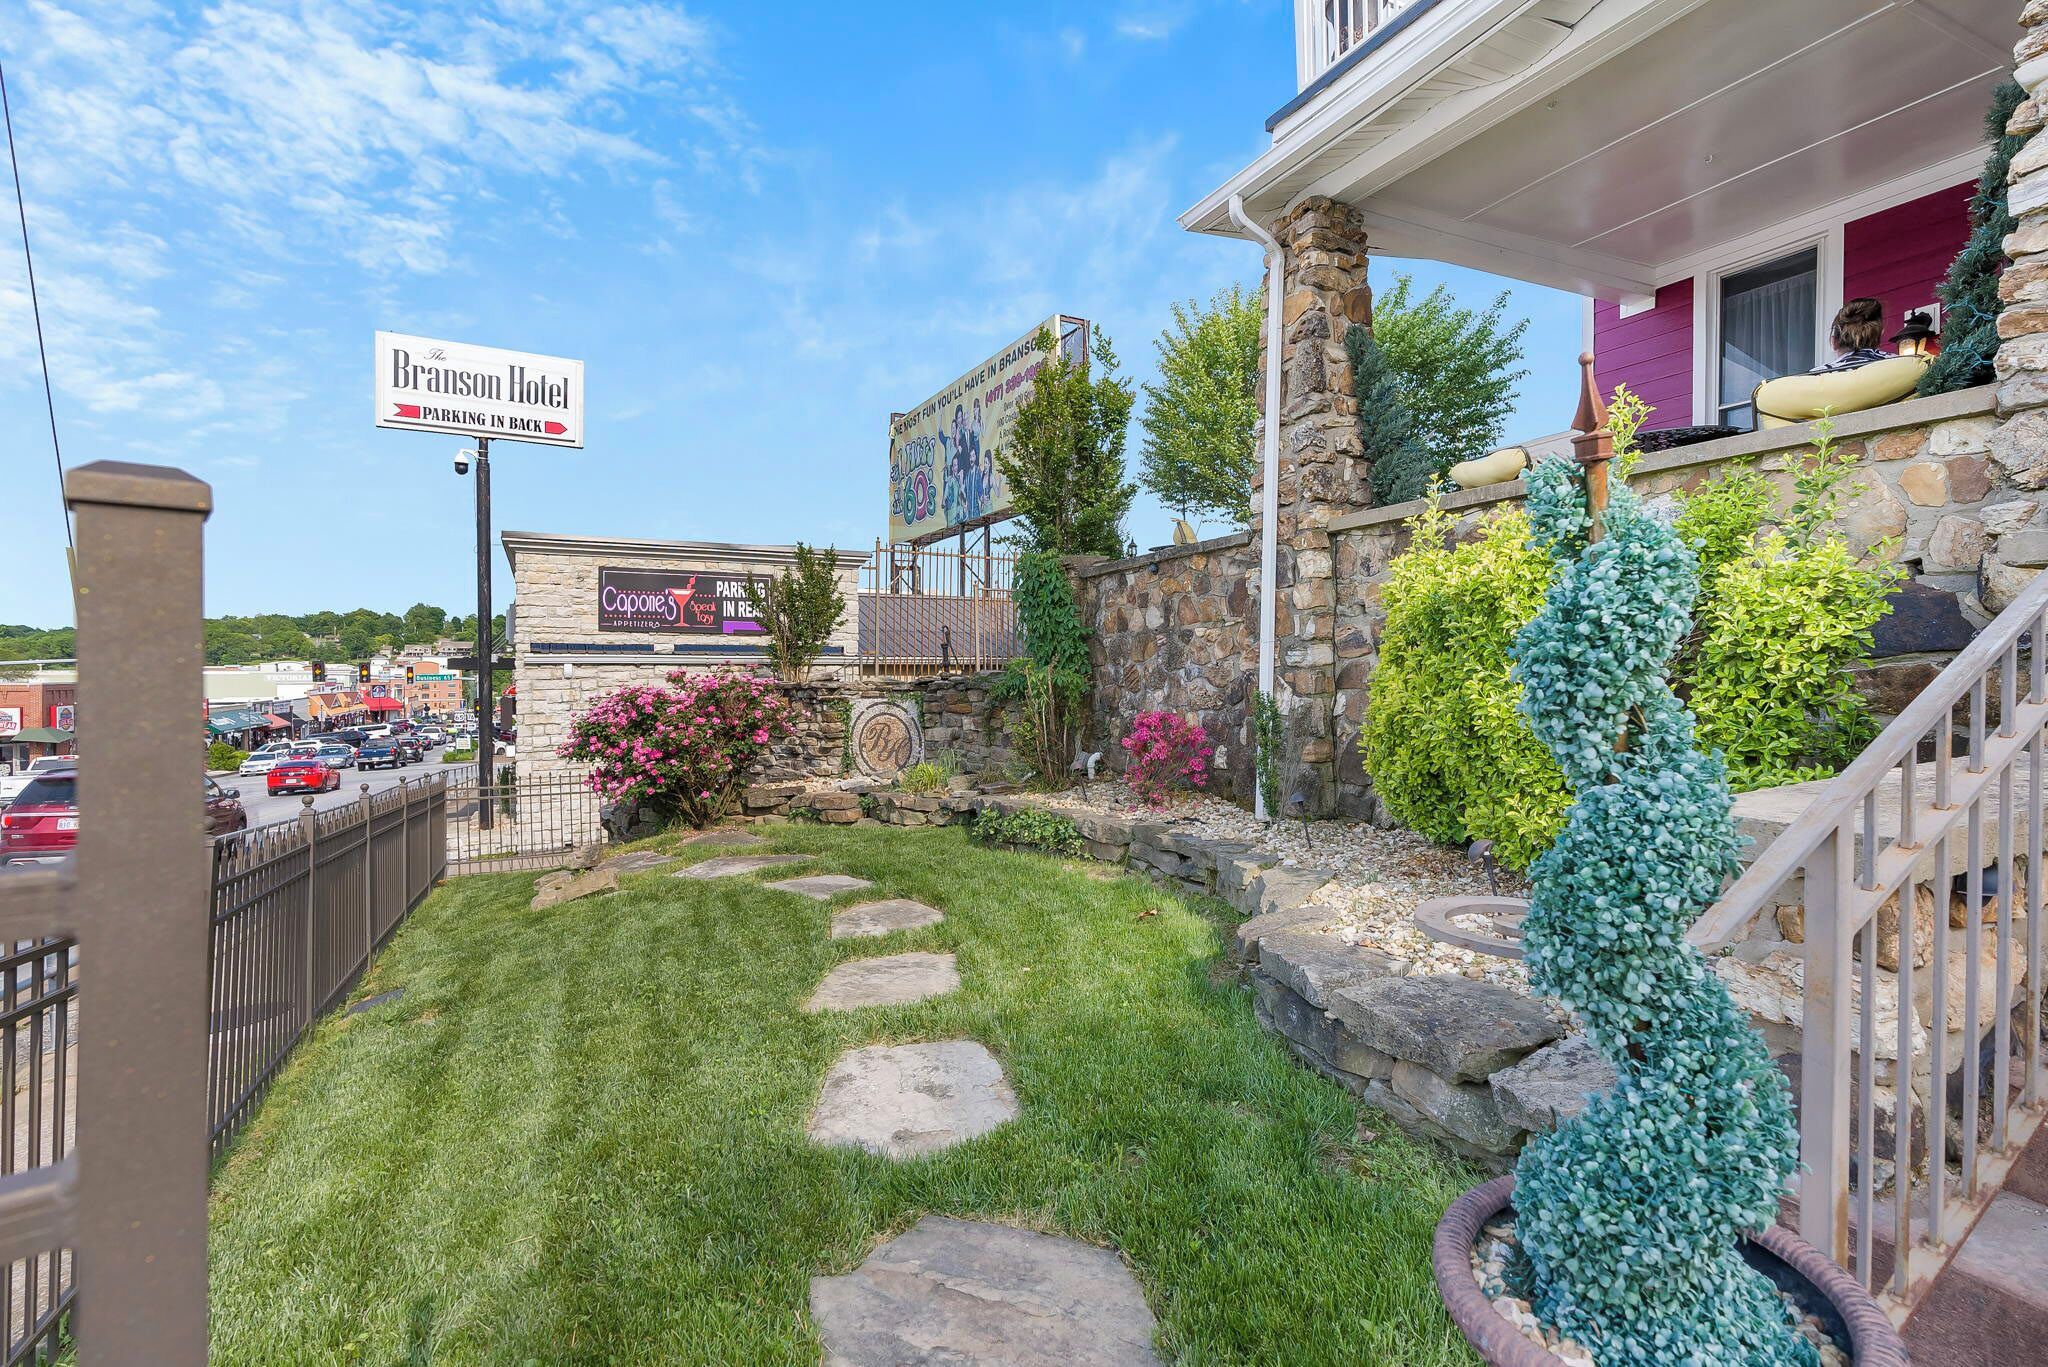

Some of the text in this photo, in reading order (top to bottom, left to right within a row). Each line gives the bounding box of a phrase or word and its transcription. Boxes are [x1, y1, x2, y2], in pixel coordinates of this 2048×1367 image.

[423, 347, 448, 362] The
[391, 348, 569, 410] Branson Hotel
[903, 413, 921, 431] MOST
[922, 402, 936, 419] FUN
[937, 388, 963, 410] YOU'LL
[964, 369, 985, 393] HAVE
[987, 364, 997, 380] IN
[999, 336, 1040, 373] BRANSO
[422, 406, 543, 433] PARKING IN BACK
[602, 586, 677, 621] Capone's
[689, 599, 716, 613] Speak
[723, 600, 737, 617] IN
